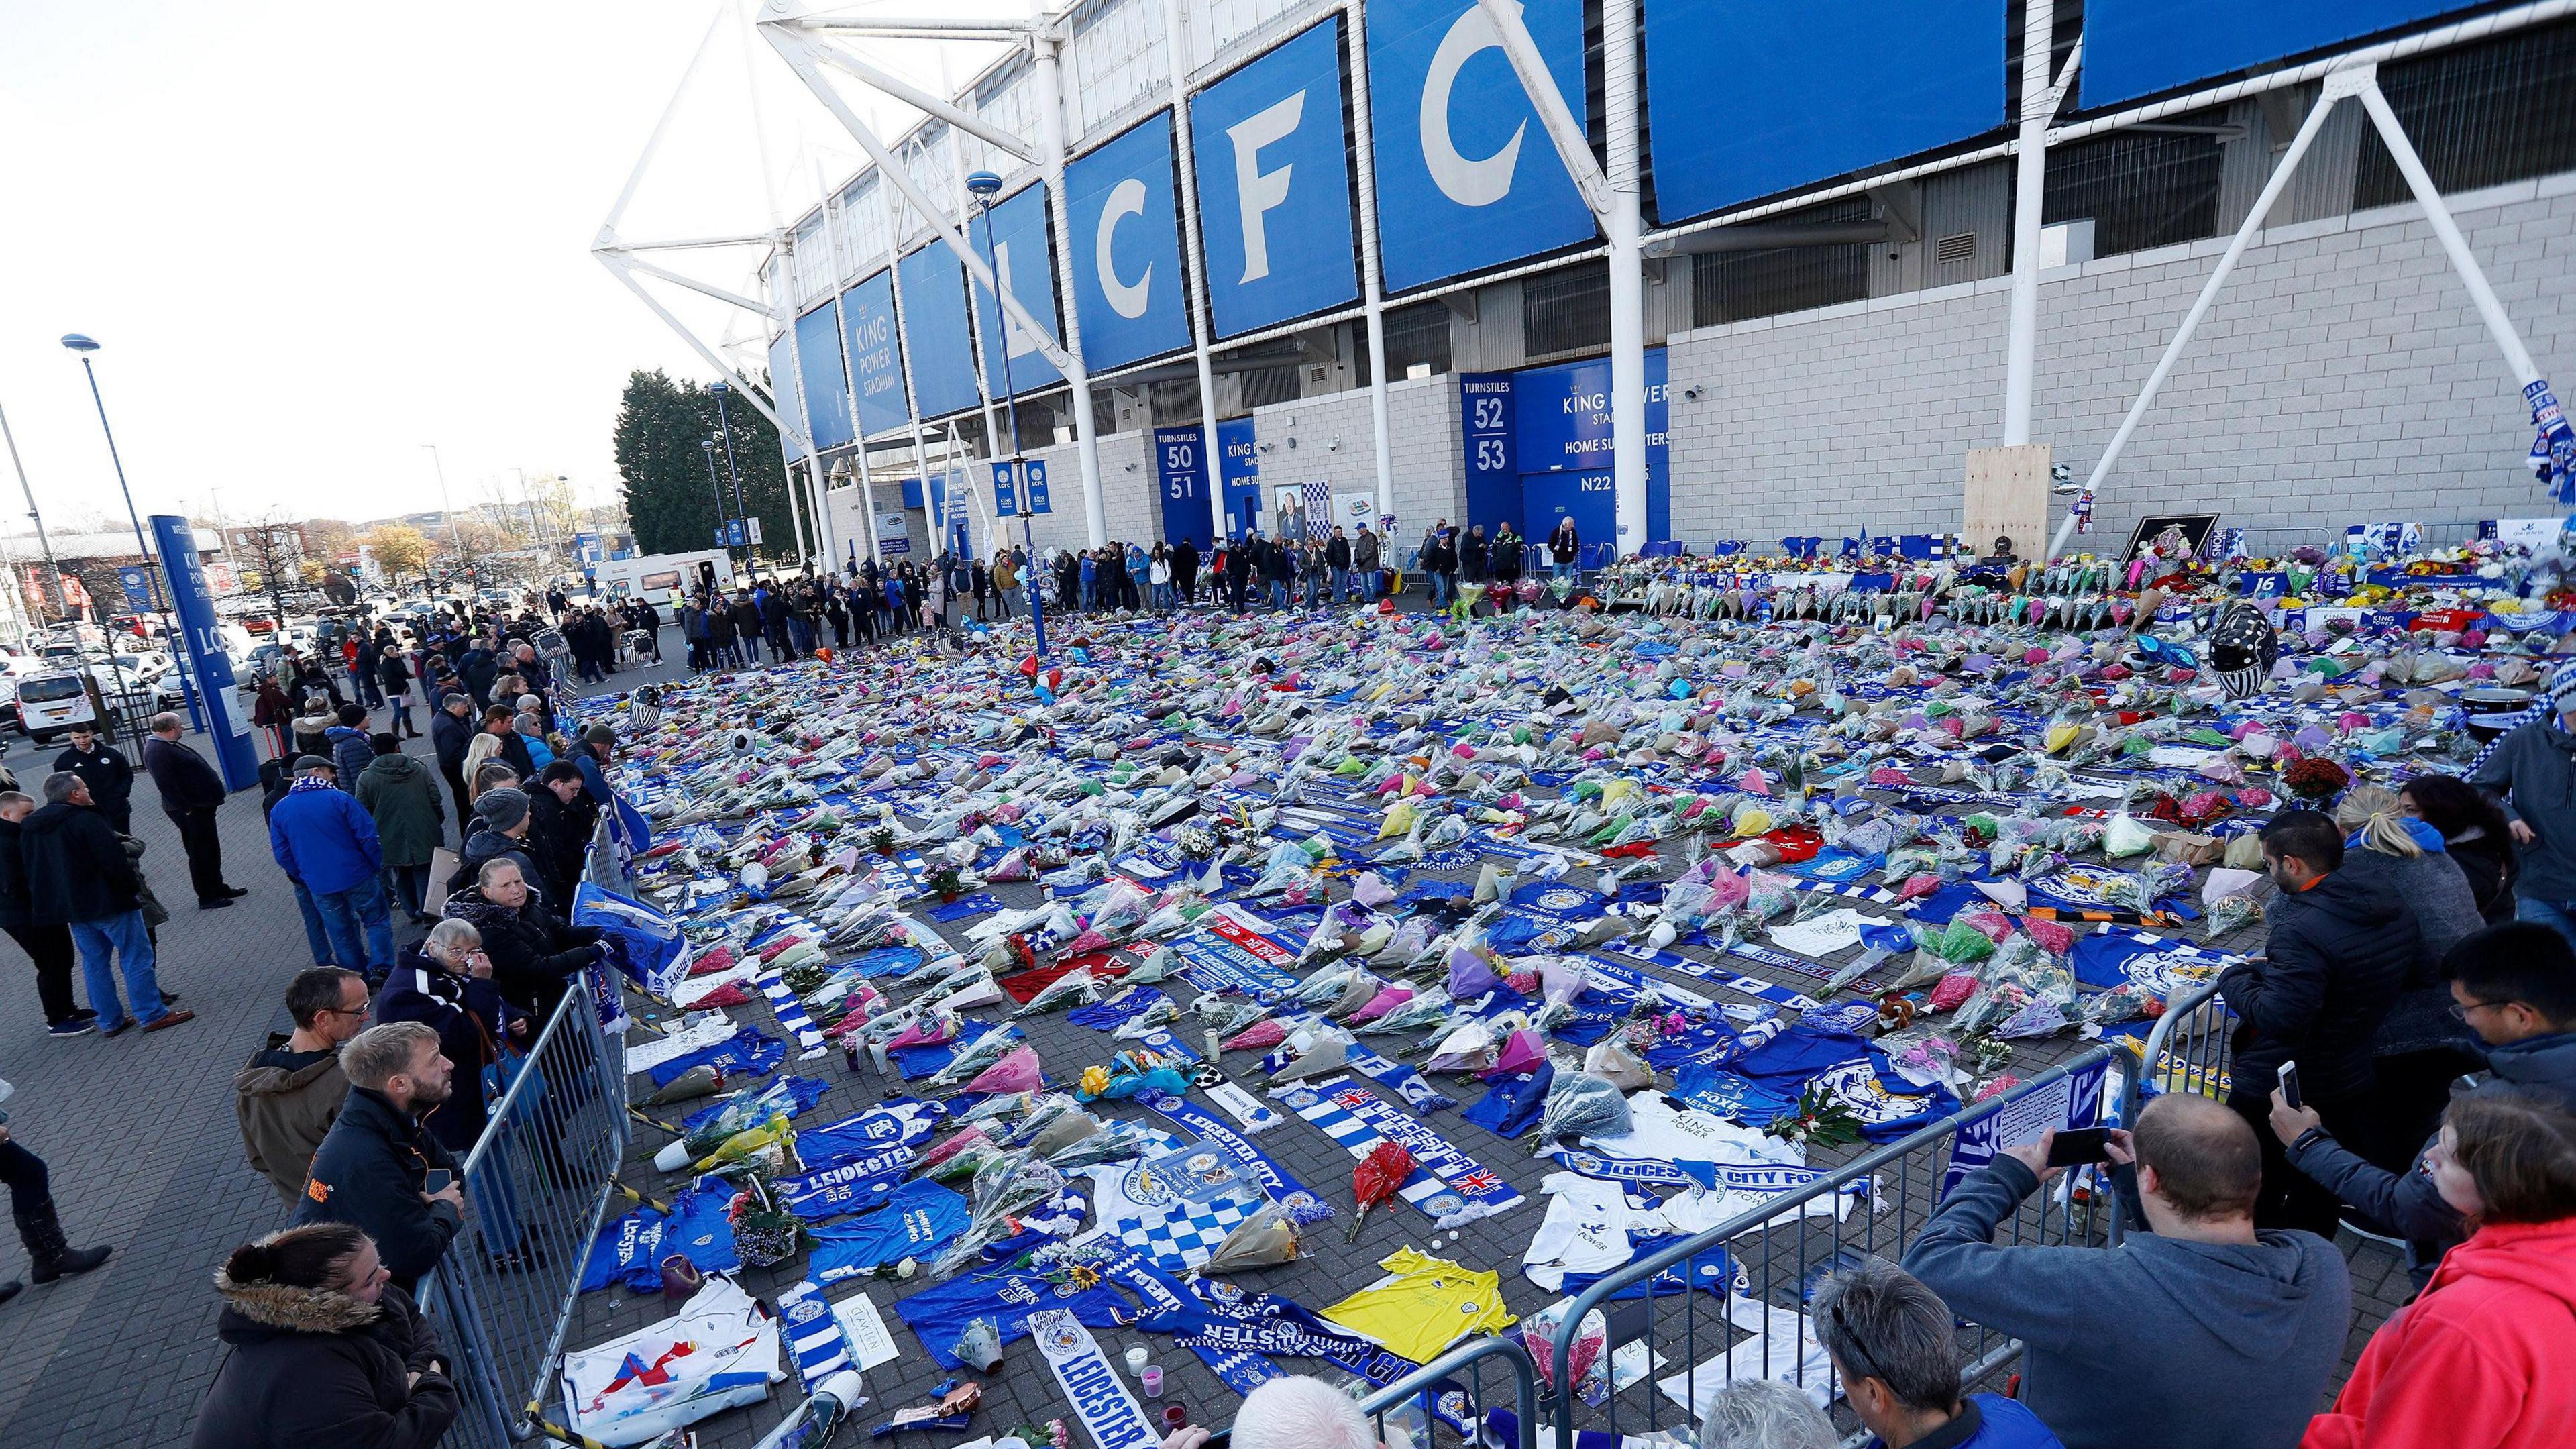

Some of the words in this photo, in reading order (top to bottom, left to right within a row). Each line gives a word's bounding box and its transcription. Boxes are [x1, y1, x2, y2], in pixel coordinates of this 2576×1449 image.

[855, 315, 887, 353] KING
[859, 347, 891, 376] POWER
[863, 372, 895, 397] STADIUM
[1464, 382, 1509, 394] TURNSTILES
[1474, 398, 1503, 429] 52
[1563, 393, 1605, 414] KING
[1158, 433, 1197, 443] TURNSTILES
[1565, 439, 1599, 455] HOME
[1167, 445, 1193, 468] 50
[1228, 443, 1251, 458] KING
[1477, 439, 1505, 470] 53
[1170, 476, 1193, 499] 51
[1231, 477, 1250, 486] HOME
[1581, 476, 1611, 492] N22
[2212, 529, 2222, 557] PIONS
[2256, 576, 2275, 591] 16
[1479, 845, 1530, 857] FOREVER
[1276, 932, 1299, 949] FOOTBALL
[1197, 950, 1241, 979] LEICESTER
[1240, 975, 1269, 991] CITY
[1682, 1096, 1719, 1113] NEVER
[1696, 1090, 1745, 1110] FOXE
[1669, 1118, 1710, 1139] POWER
[1676, 1113, 1715, 1134] KING
[1369, 1101, 1479, 1172] LEICESTER
[1379, 1120, 1431, 1163] CITY
[1180, 1112, 1258, 1163] LEICESTER
[1250, 1160, 1284, 1189] CITY
[1612, 1164, 1682, 1178] LEICES
[1727, 1171, 1777, 1184] CITY
[1784, 1172, 1813, 1184] FC
[825, 1187, 838, 1203] WER
[837, 1184, 853, 1201] NG
[1578, 1231, 1608, 1252] POWER
[1006, 1277, 1040, 1305] WALKERS
[1057, 1349, 1149, 1449] LEICESTER
